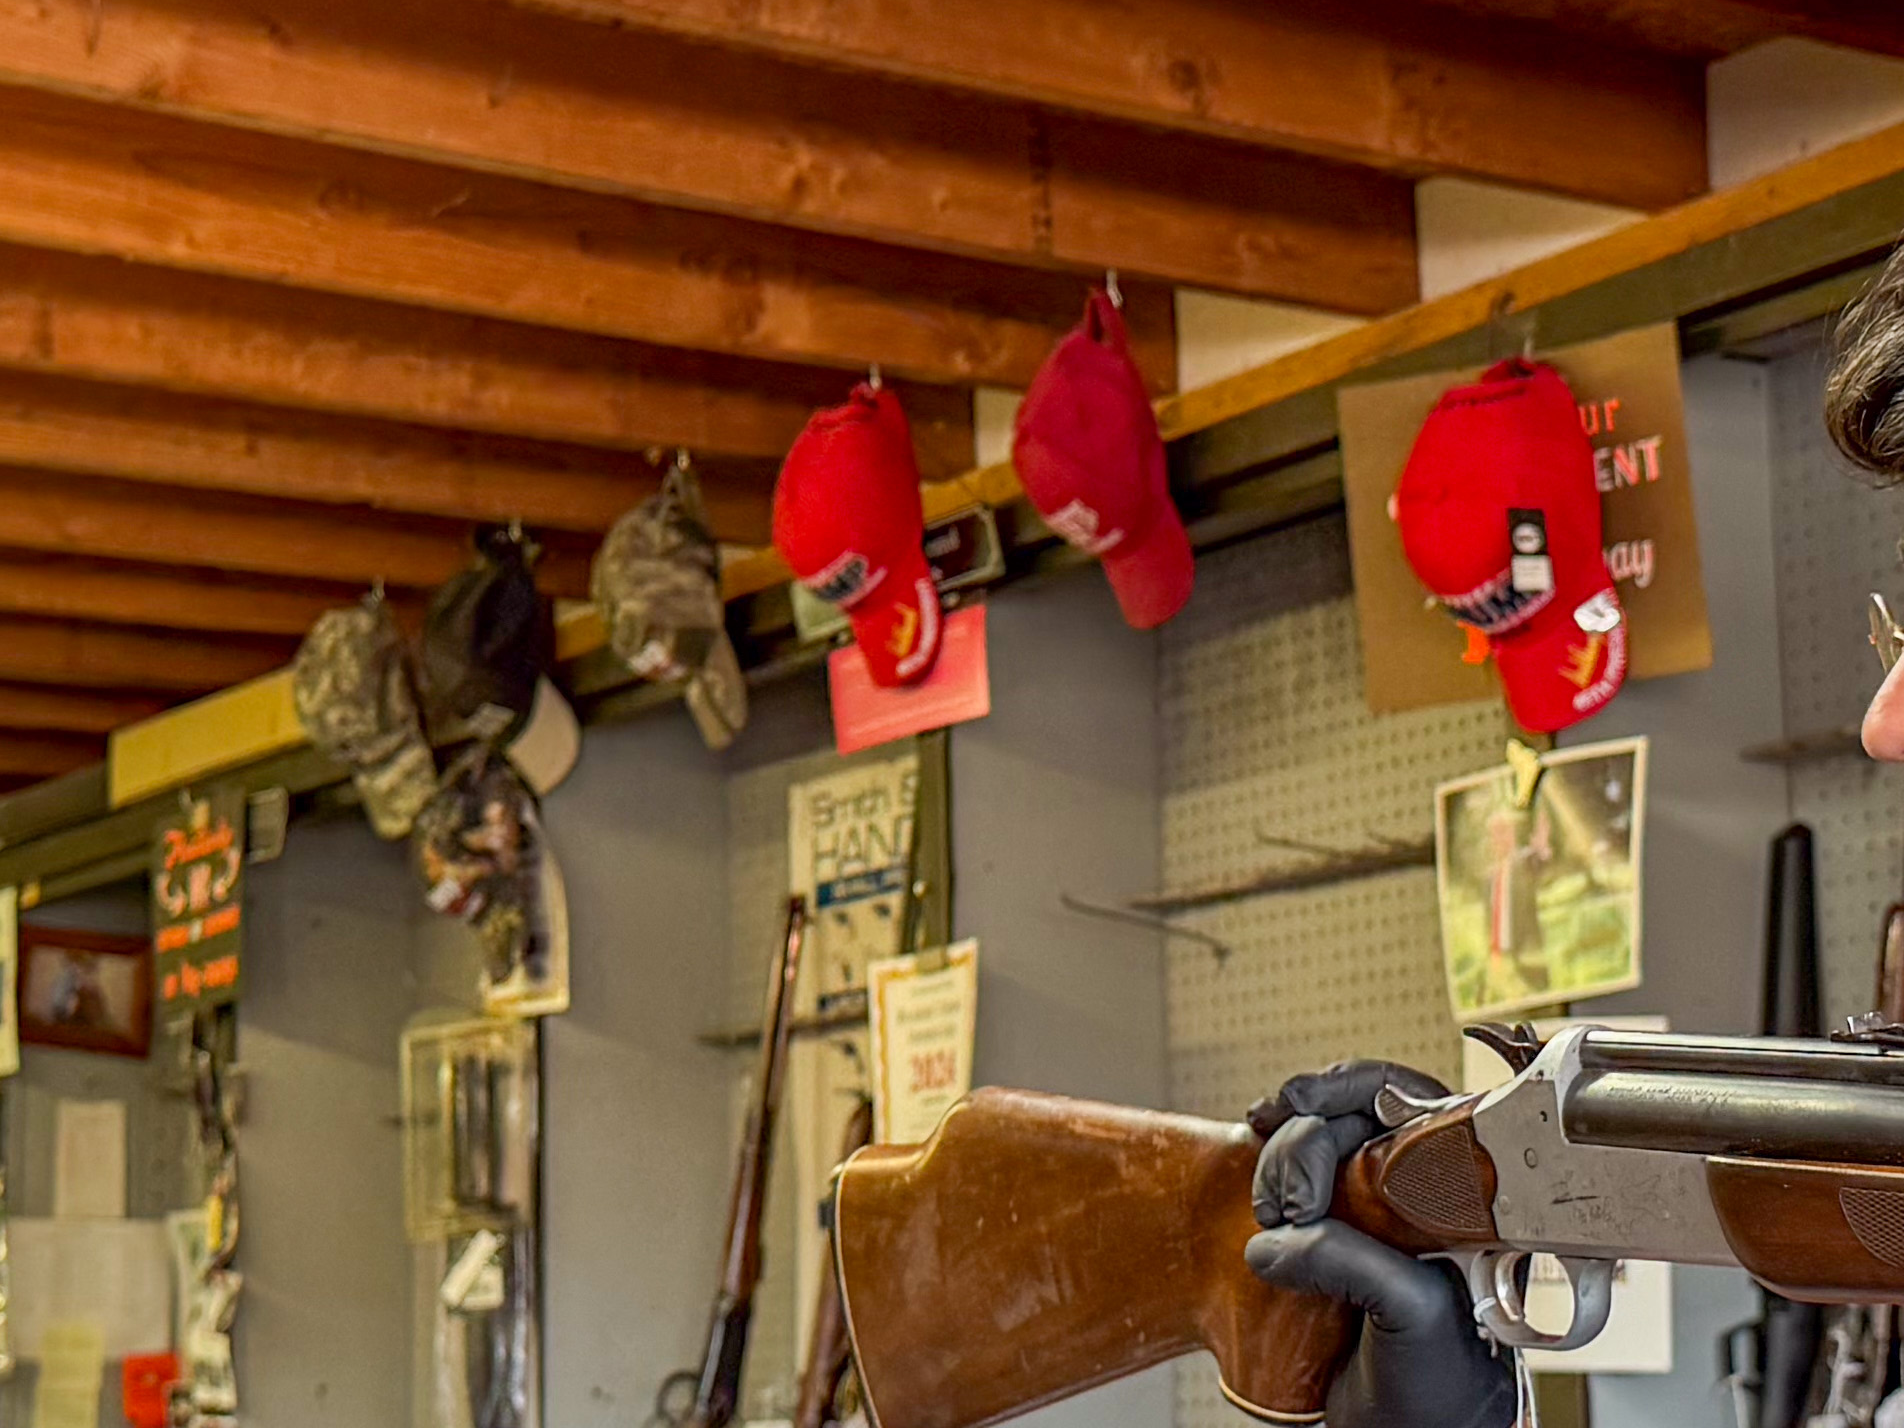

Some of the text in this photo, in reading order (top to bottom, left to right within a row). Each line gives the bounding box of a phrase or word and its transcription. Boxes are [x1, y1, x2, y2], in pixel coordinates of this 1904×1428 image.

[1578, 398, 1620, 436] ur
[1593, 434, 1662, 492] ENT
[1602, 539, 1654, 589] ay
[812, 814, 912, 878] HAN
